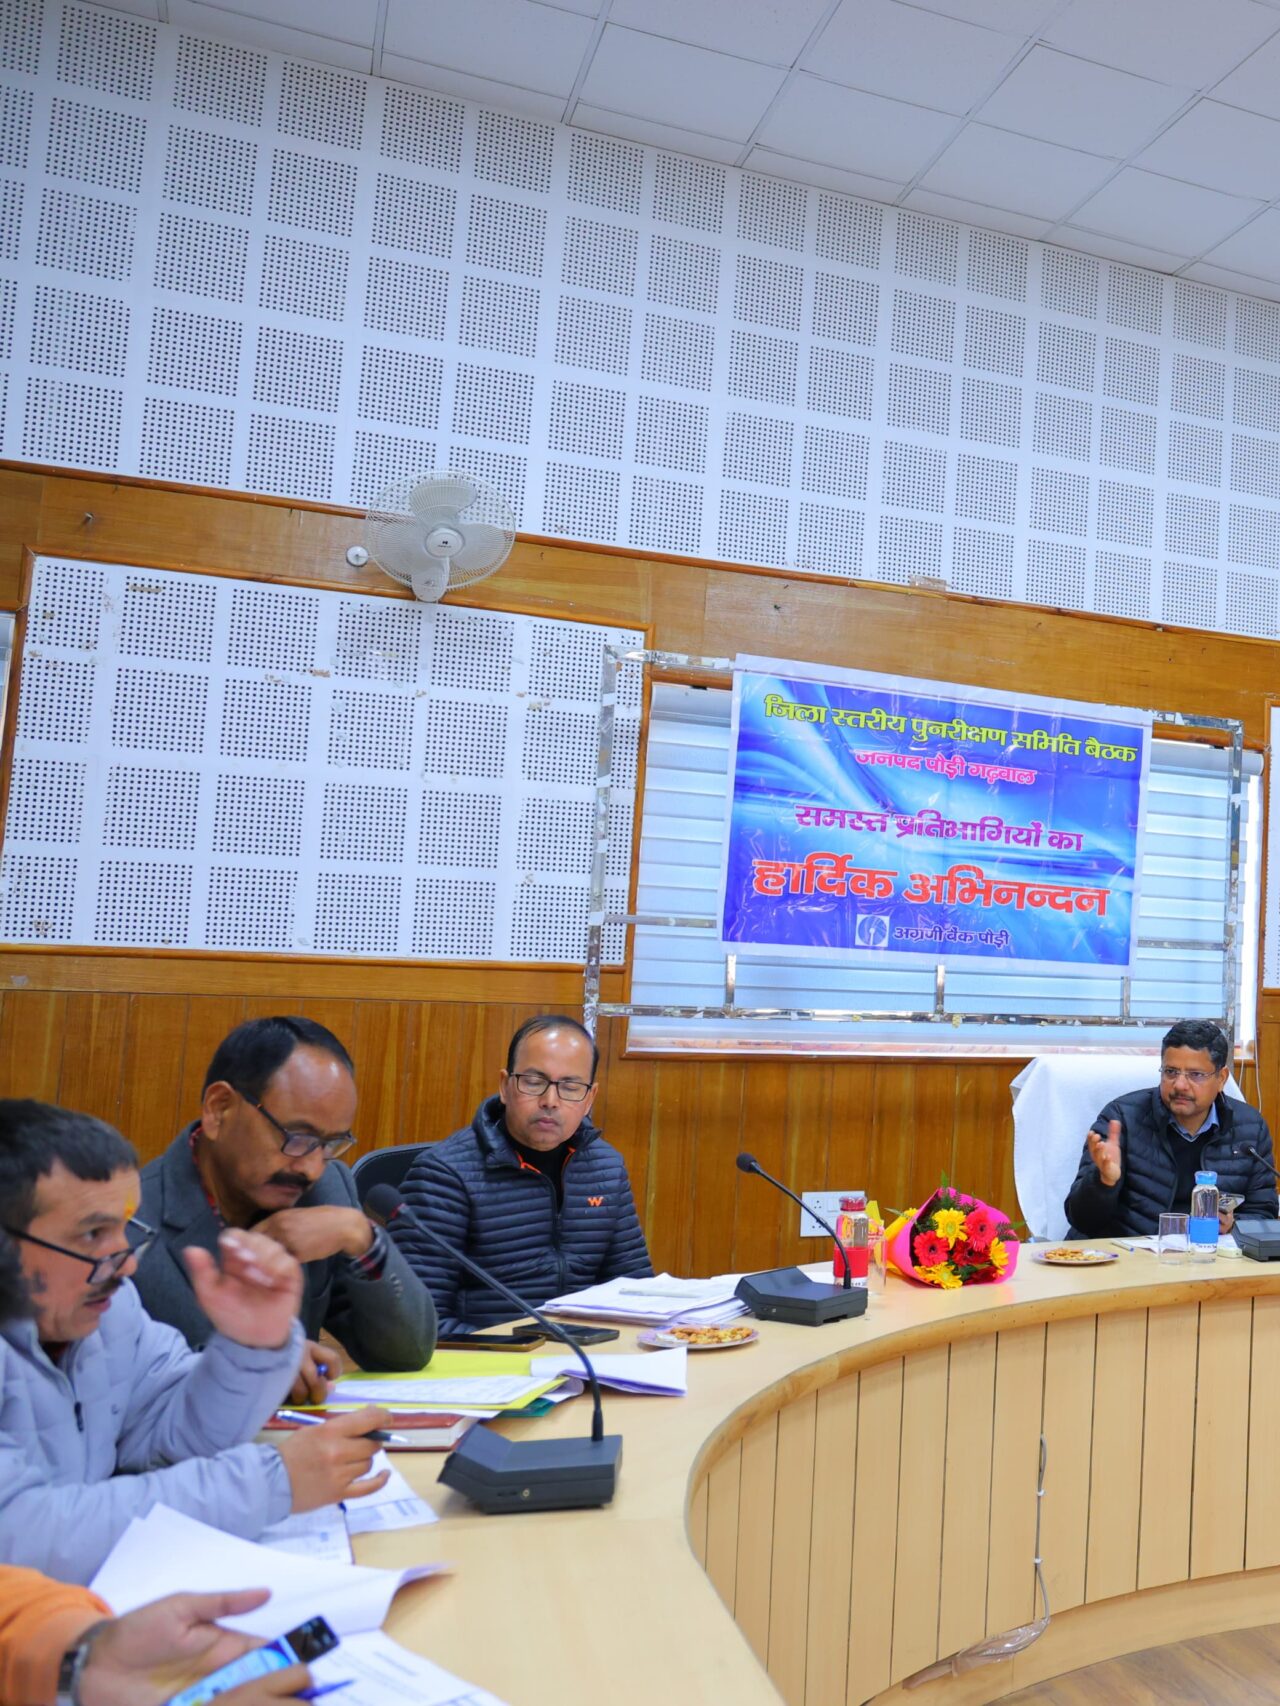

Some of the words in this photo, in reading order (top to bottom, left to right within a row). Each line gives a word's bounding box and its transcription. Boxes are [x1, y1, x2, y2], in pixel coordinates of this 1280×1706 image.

[764, 694, 828, 724] जिला
[831, 708, 907, 733] स्तरीय
[911, 718, 1008, 746] पुनरीक्षण
[1011, 729, 1082, 756] समिति
[1084, 736, 1138, 762] बैठक
[855, 750, 923, 771] जनपद
[968, 762, 1037, 785] गढ़वाल
[794, 805, 889, 832] समस्त
[894, 809, 1044, 847] प्रतिभागियों
[1047, 830, 1084, 851] का
[752, 851, 898, 898] हार्दिक
[903, 864, 1111, 916] अभिनन्दन
[894, 925, 944, 942] अग्रणी
